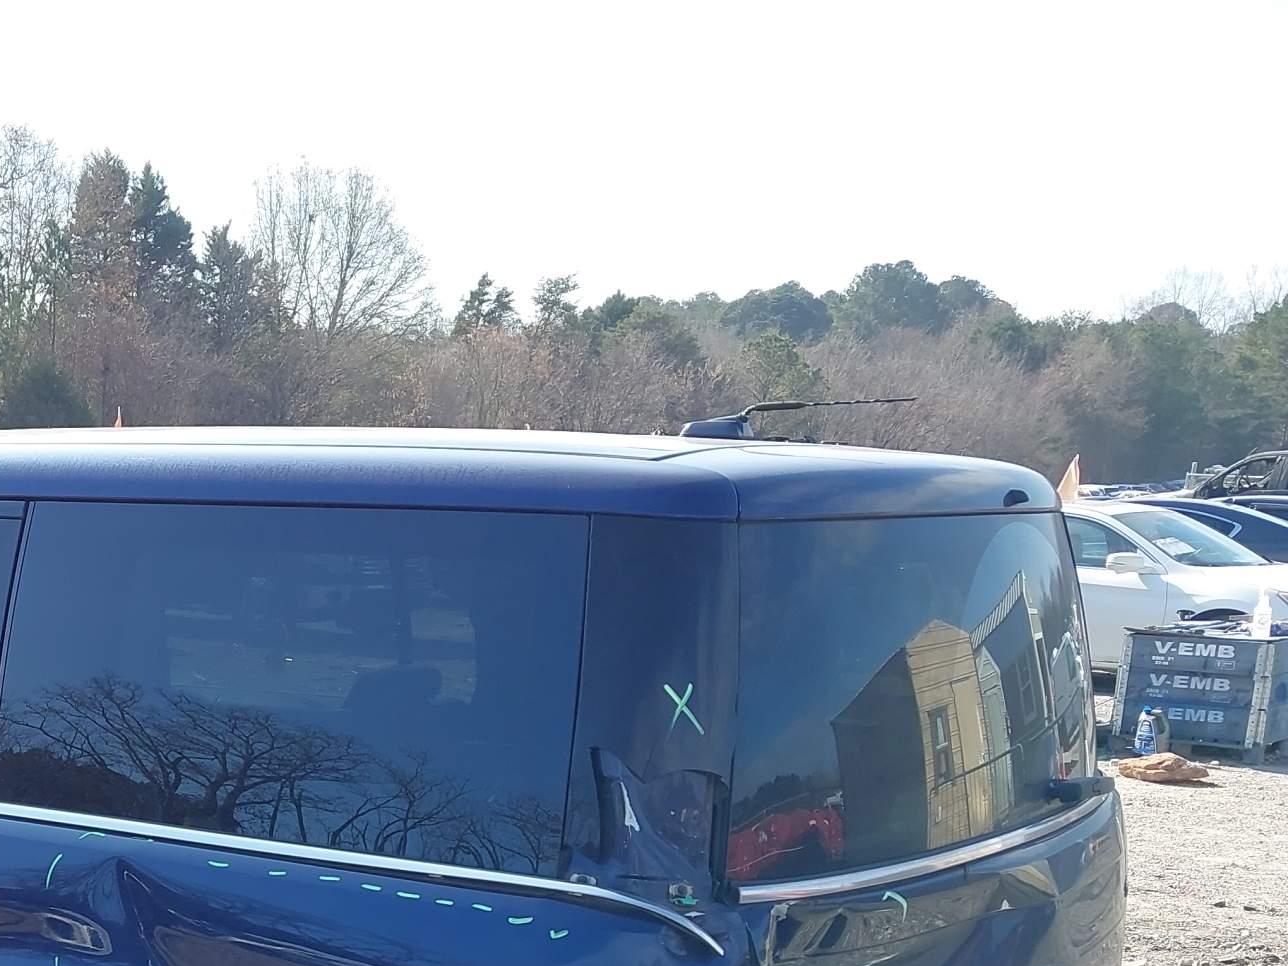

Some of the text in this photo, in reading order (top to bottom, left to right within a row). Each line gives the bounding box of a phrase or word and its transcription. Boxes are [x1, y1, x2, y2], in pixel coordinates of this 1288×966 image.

[1154, 640, 1235, 658] V-EMB
[1149, 673, 1231, 692] V-EMB
[1167, 707, 1225, 723] EMB
